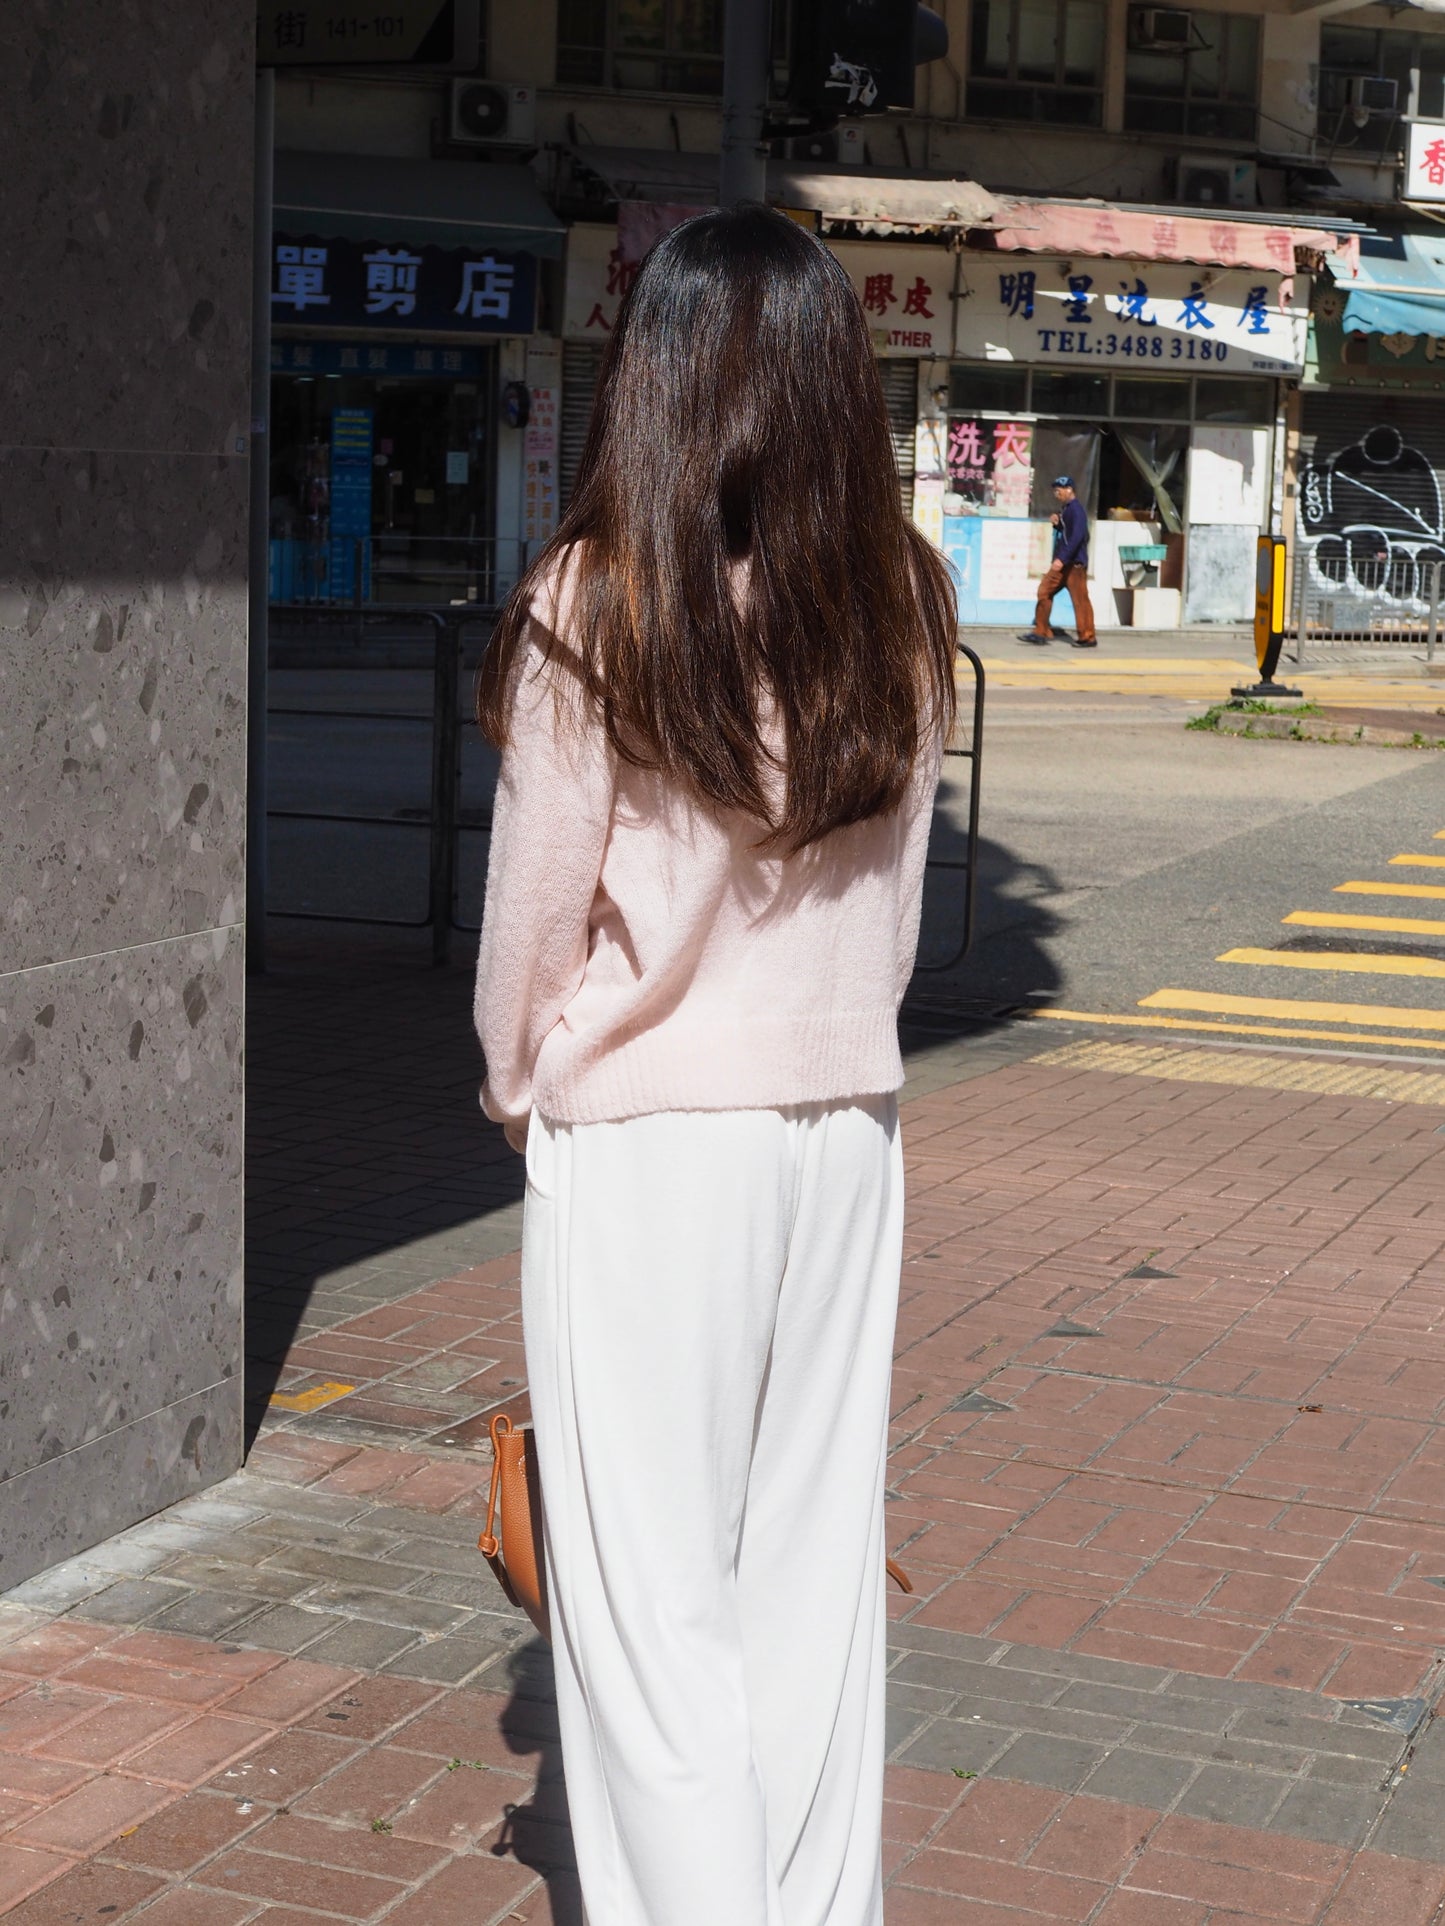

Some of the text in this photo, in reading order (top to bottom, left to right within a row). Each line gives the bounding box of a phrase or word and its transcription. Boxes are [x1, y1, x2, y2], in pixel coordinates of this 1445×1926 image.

[325, 16, 405, 38] 141-101
[1419, 139, 1445, 185] 香
[271, 246, 516, 320] 單剪店
[863, 273, 935, 319] 膠皮
[1000, 270, 1271, 335] 明星洗衣屋
[948, 419, 1032, 468] 洗衣
